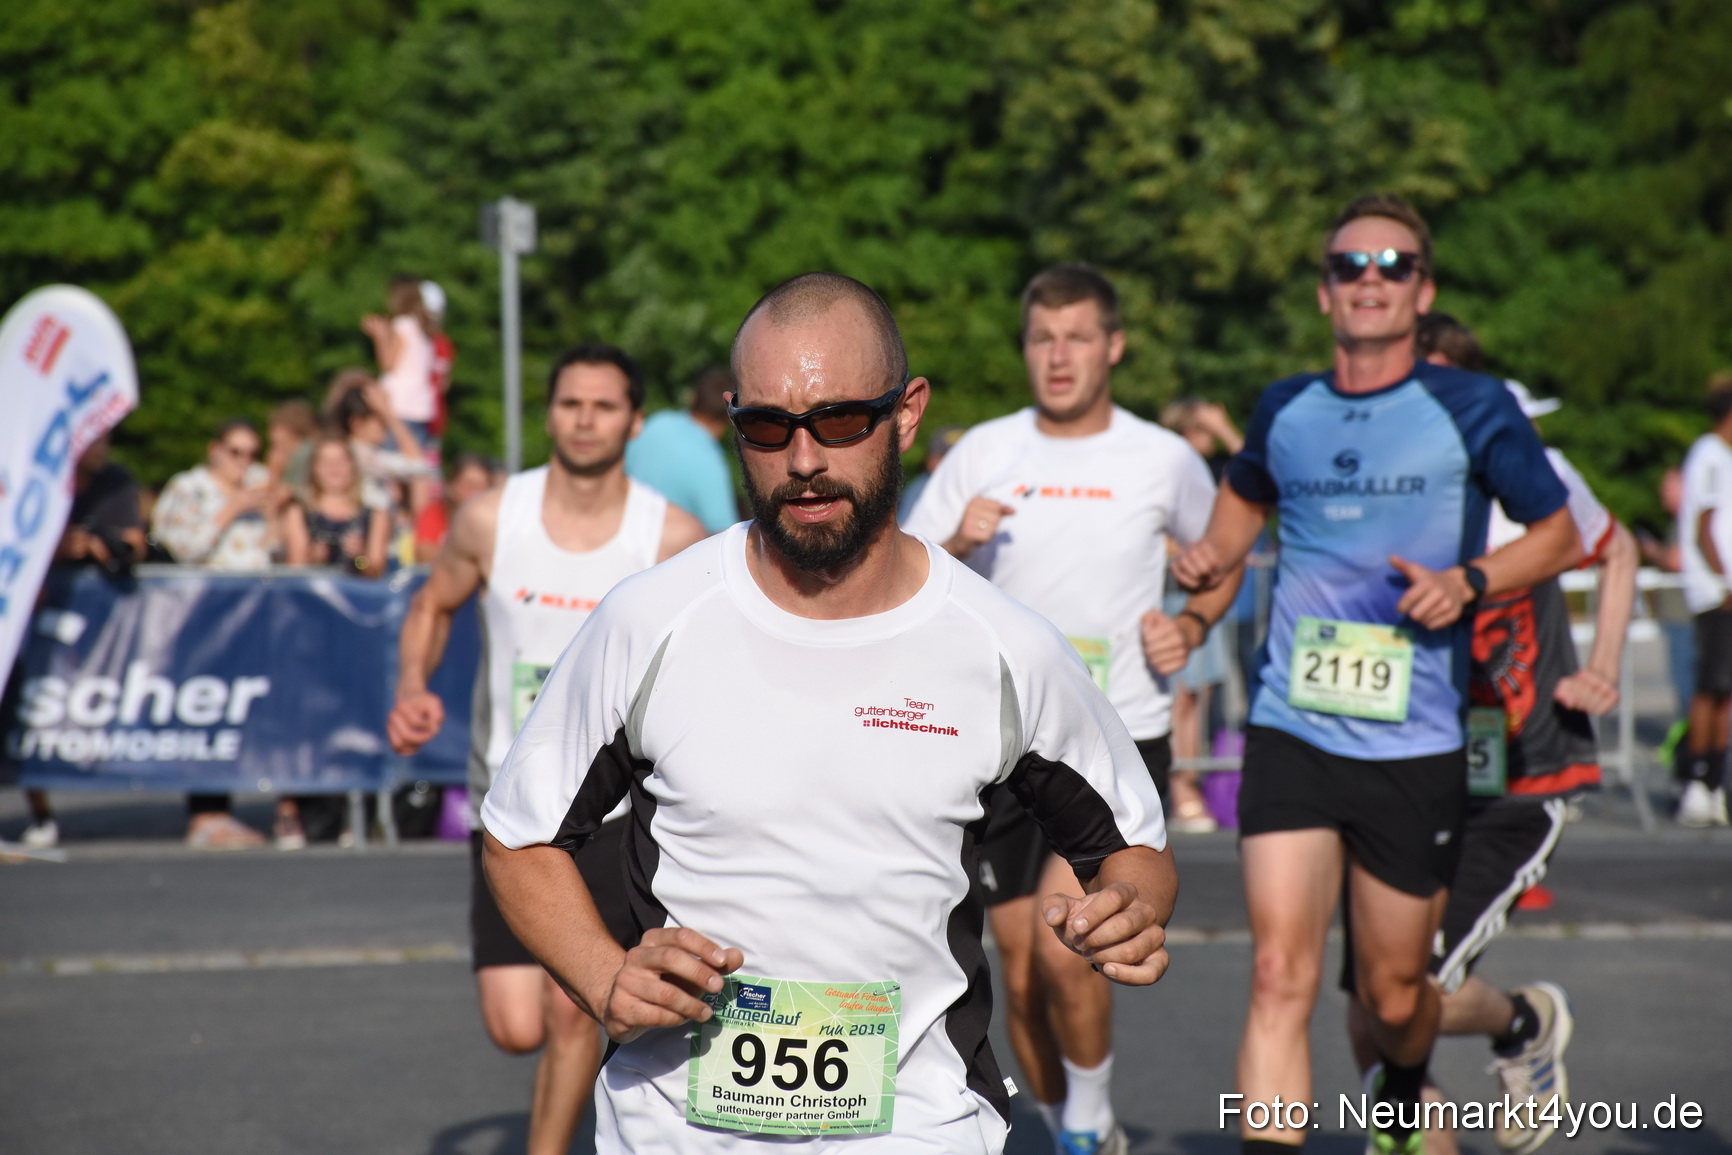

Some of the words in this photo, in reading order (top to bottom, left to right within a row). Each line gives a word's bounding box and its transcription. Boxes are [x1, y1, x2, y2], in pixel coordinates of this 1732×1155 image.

[1304, 650, 1392, 692] 2119
[854, 706, 926, 721] guttenberger
[904, 698, 934, 711] Team
[872, 718, 959, 737] lichttechnik
[743, 990, 766, 999] Fischer
[721, 1003, 802, 1026] firmenlauf
[849, 1023, 886, 1036] 2019
[731, 1033, 849, 1092] 956
[712, 1085, 785, 1107] Baumann
[790, 1094, 867, 1110] Christoph
[716, 1103, 783, 1121] guttenberger
[786, 1110, 824, 1121] partner
[827, 1110, 860, 1120] GmbH
